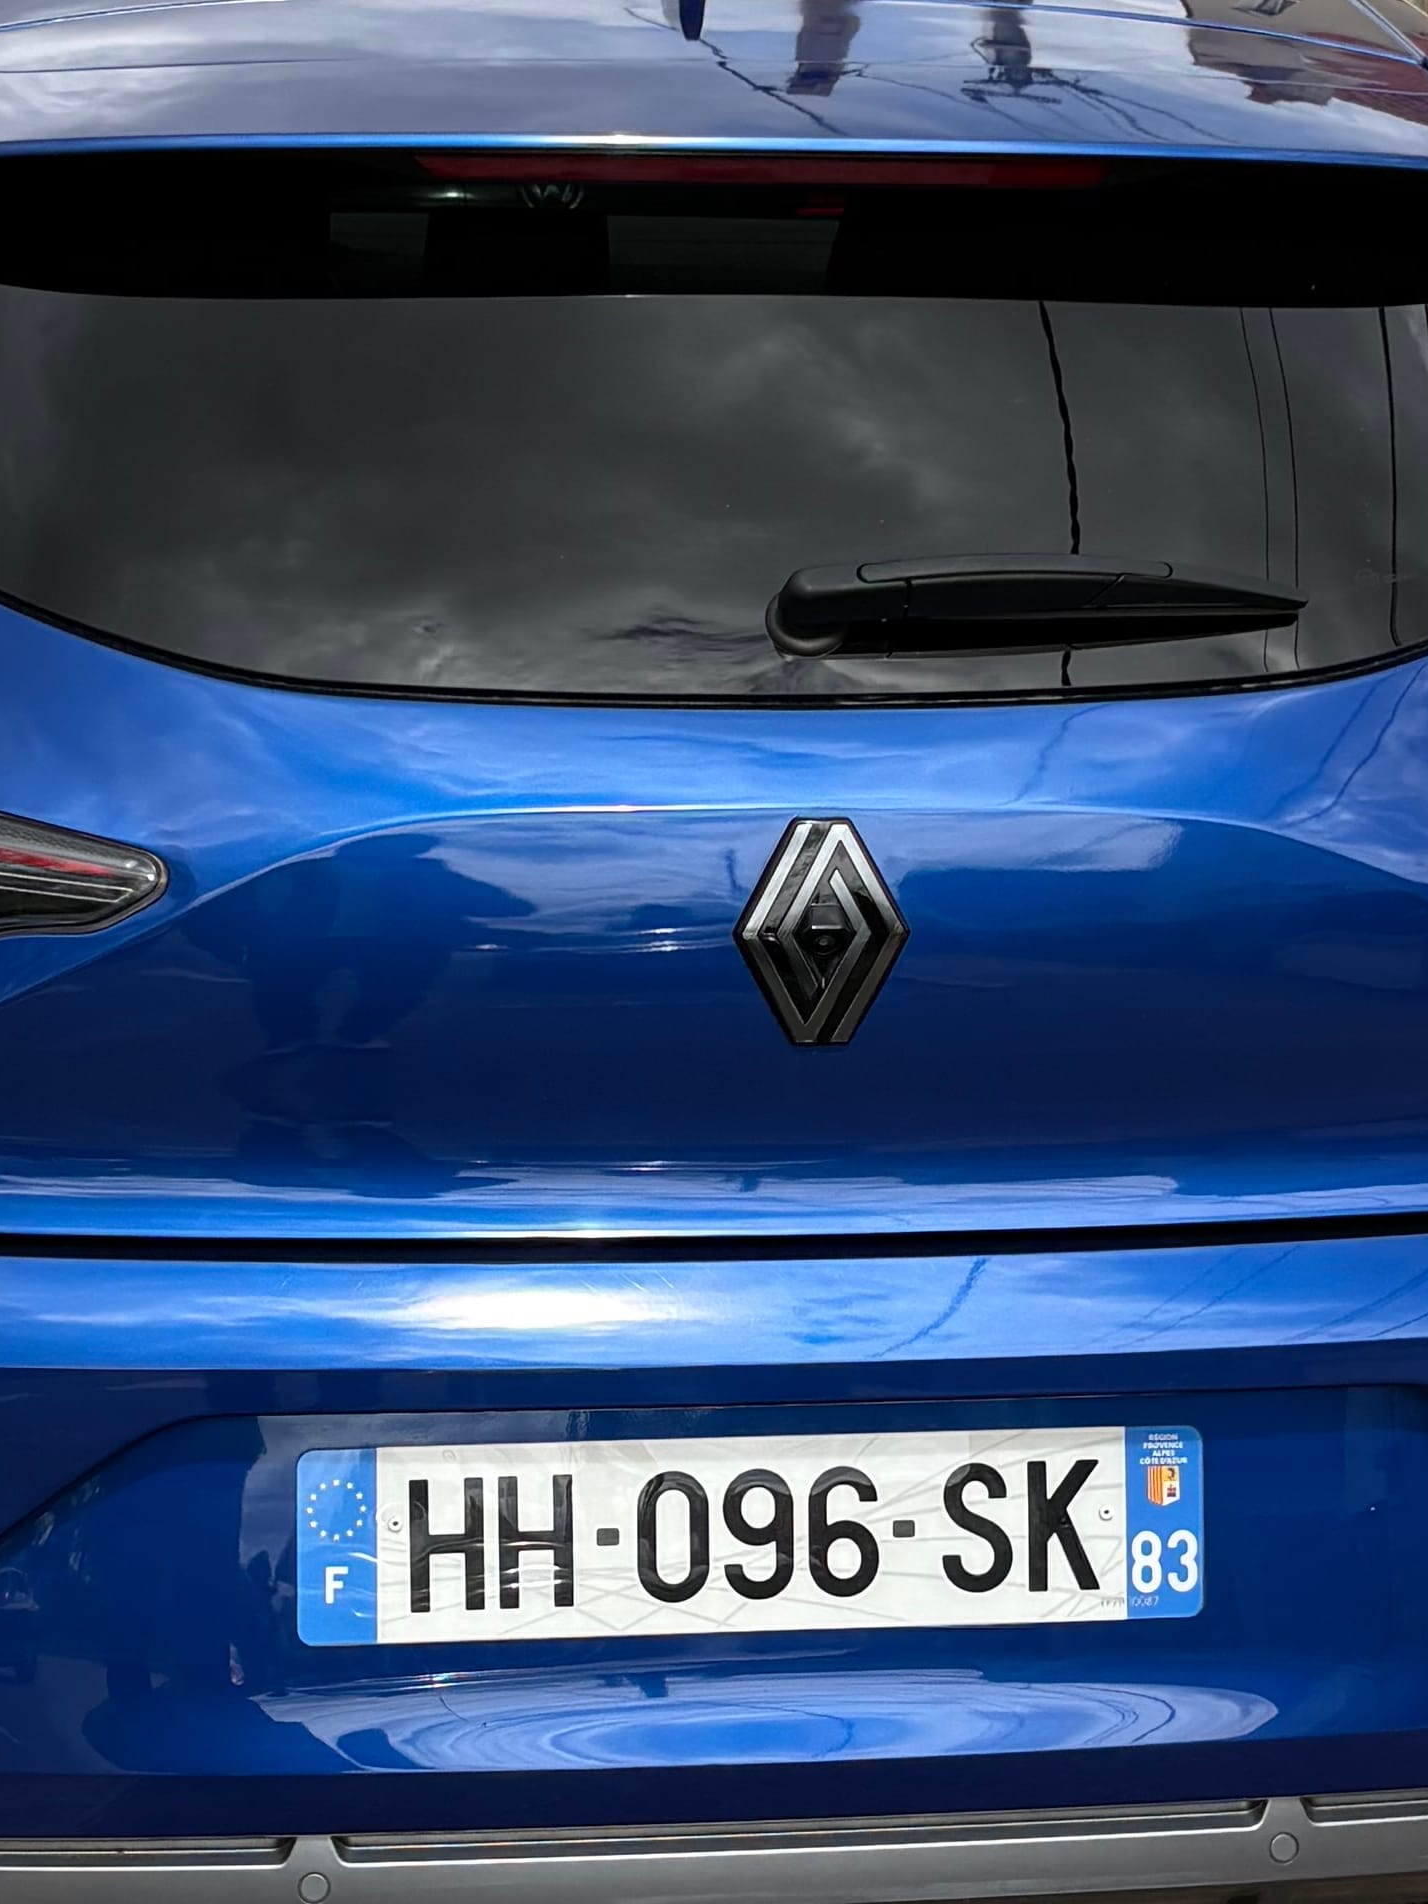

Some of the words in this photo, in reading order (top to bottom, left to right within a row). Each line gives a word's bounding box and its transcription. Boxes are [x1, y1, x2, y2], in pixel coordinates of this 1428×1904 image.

[1142, 1441, 1184, 1449] PROVENCE
[409, 1459, 1100, 1613] HH-096-SK
[1131, 1529, 1198, 1594] 83
[325, 1566, 349, 1604] F
